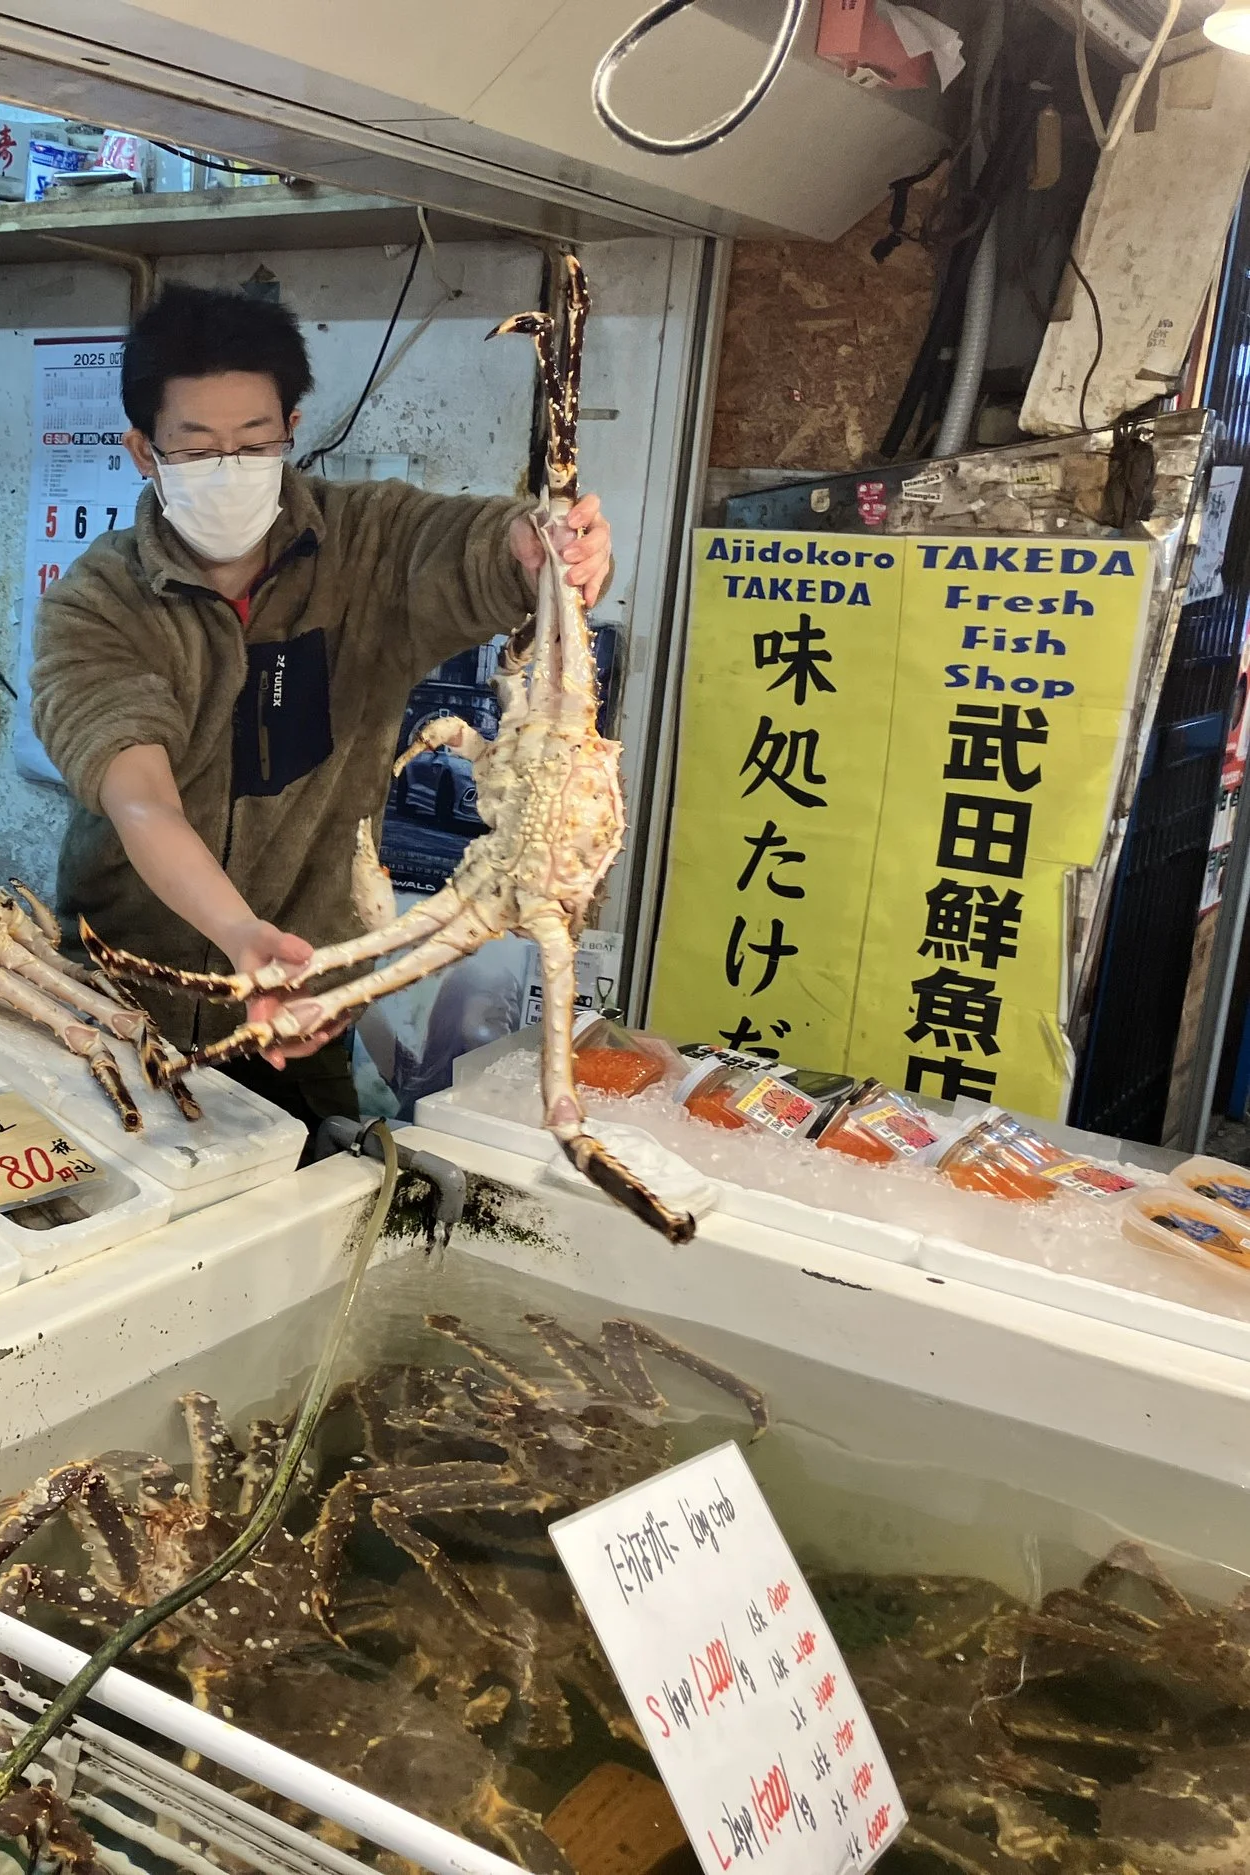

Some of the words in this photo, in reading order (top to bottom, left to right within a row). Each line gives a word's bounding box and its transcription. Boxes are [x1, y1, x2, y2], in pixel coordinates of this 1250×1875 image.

[73, 353, 105, 366] 2025
[108, 455, 120, 470] 30
[46, 506, 58, 538] 5
[75, 506, 87, 539] 6
[106, 508, 118, 530] 7
[706, 537, 896, 569] Ajidokoro
[916, 544, 1136, 577] TAKEDA
[723, 575, 872, 607] TAKEDA
[944, 585, 1095, 617] Fresh
[961, 625, 1067, 656] Fish
[273, 670, 283, 707] TULTEX
[944, 663, 1075, 699] Shop
[719, 613, 837, 1060] 味処たけだ
[677, 1498, 720, 1553] king
[709, 1477, 735, 1528] crab
[646, 1695, 670, 1738] S
[708, 1830, 732, 1870] L
